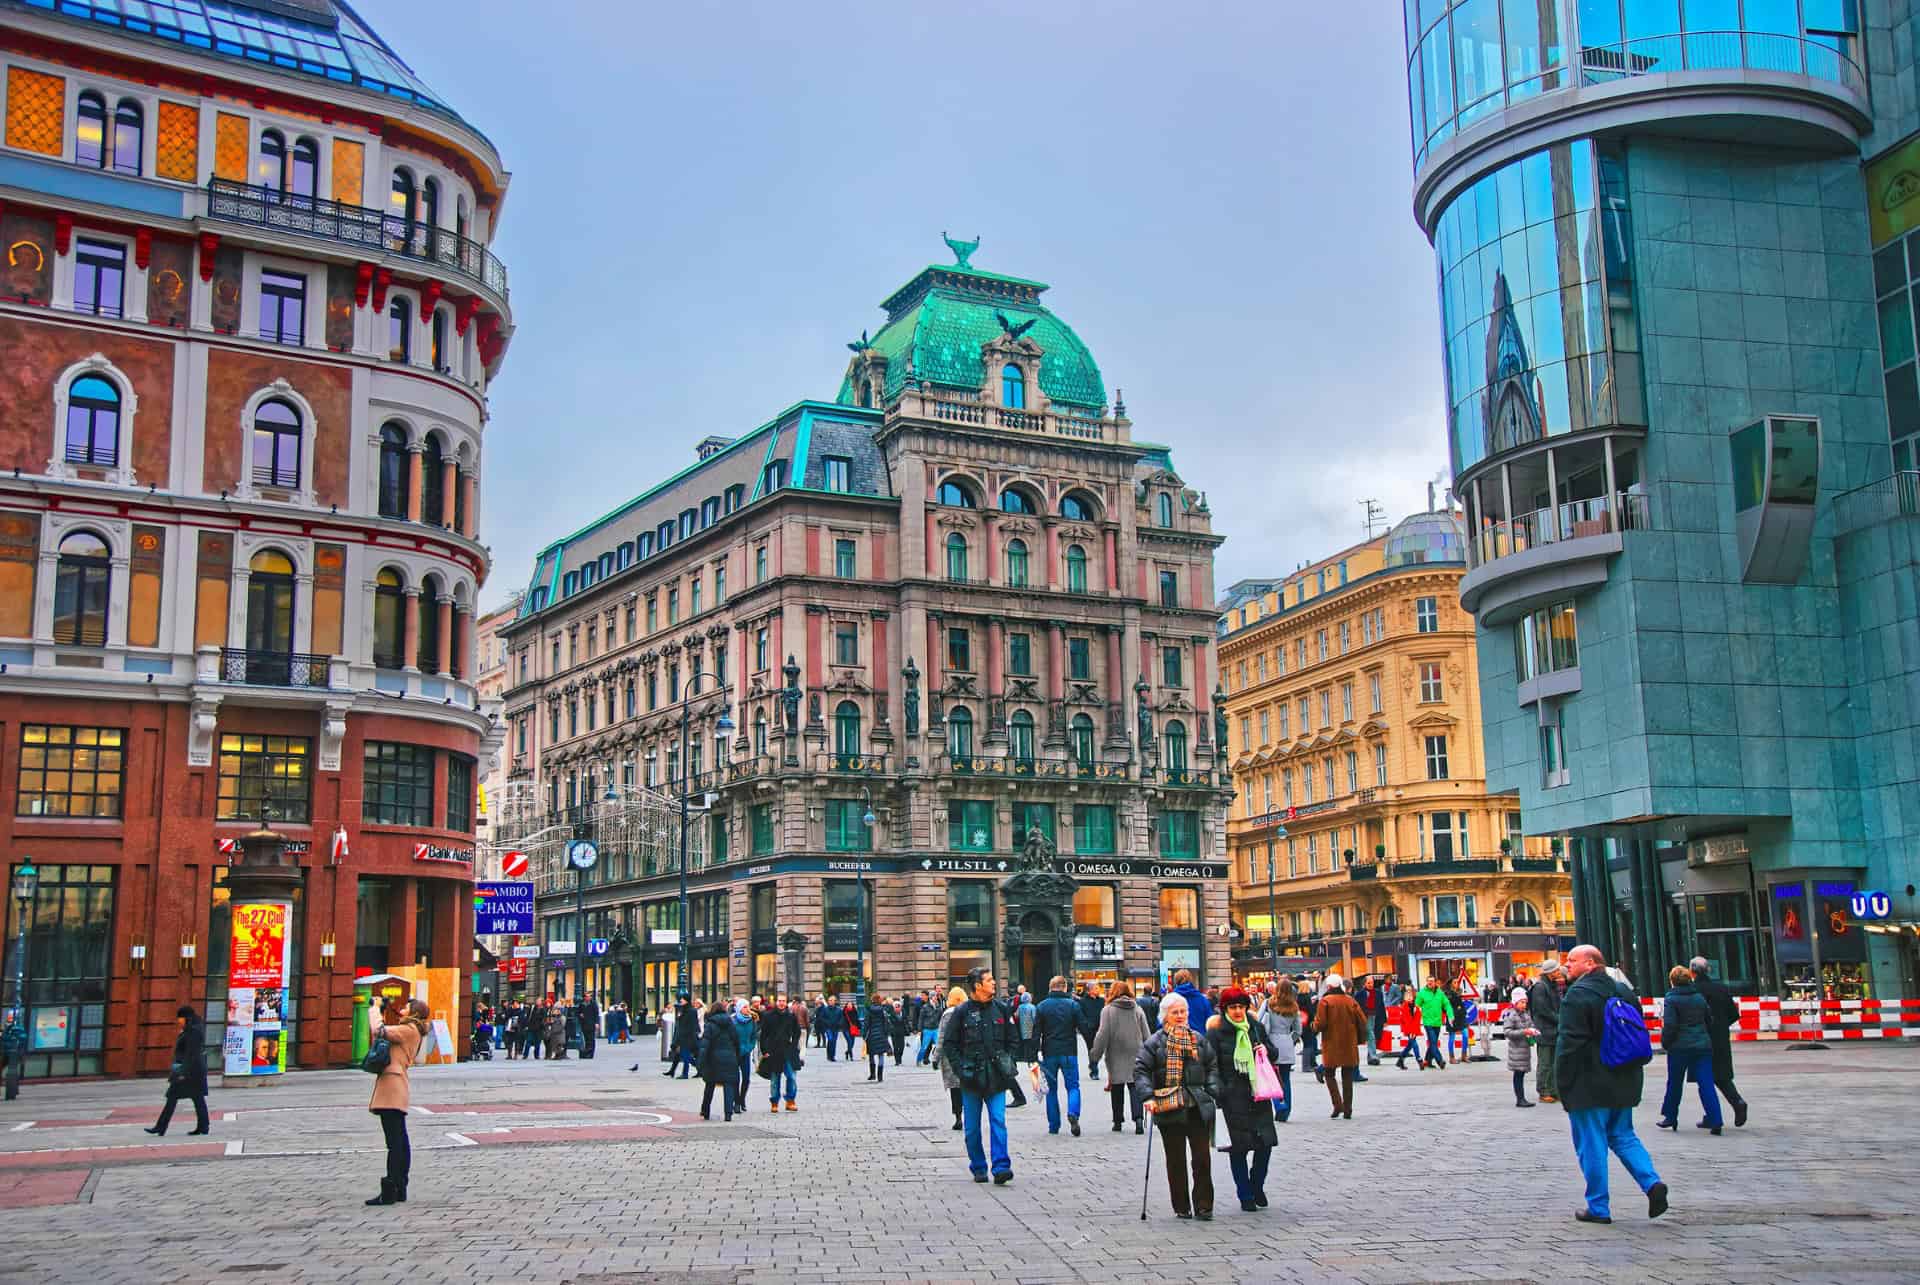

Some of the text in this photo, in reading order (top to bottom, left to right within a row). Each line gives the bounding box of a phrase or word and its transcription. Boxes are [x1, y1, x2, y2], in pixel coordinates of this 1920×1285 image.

[429, 844, 450, 858] Bank
[938, 860, 992, 871] PILSTL
[1078, 863, 1116, 875] OMEGA
[1164, 868, 1198, 878] OMEGA
[478, 901, 533, 914] CHANGE
[1852, 897, 1889, 917] U U
[237, 911, 250, 924] The
[251, 909, 266, 924] 27
[595, 942, 607, 954] U
[1424, 939, 1473, 948] Marionnaud
